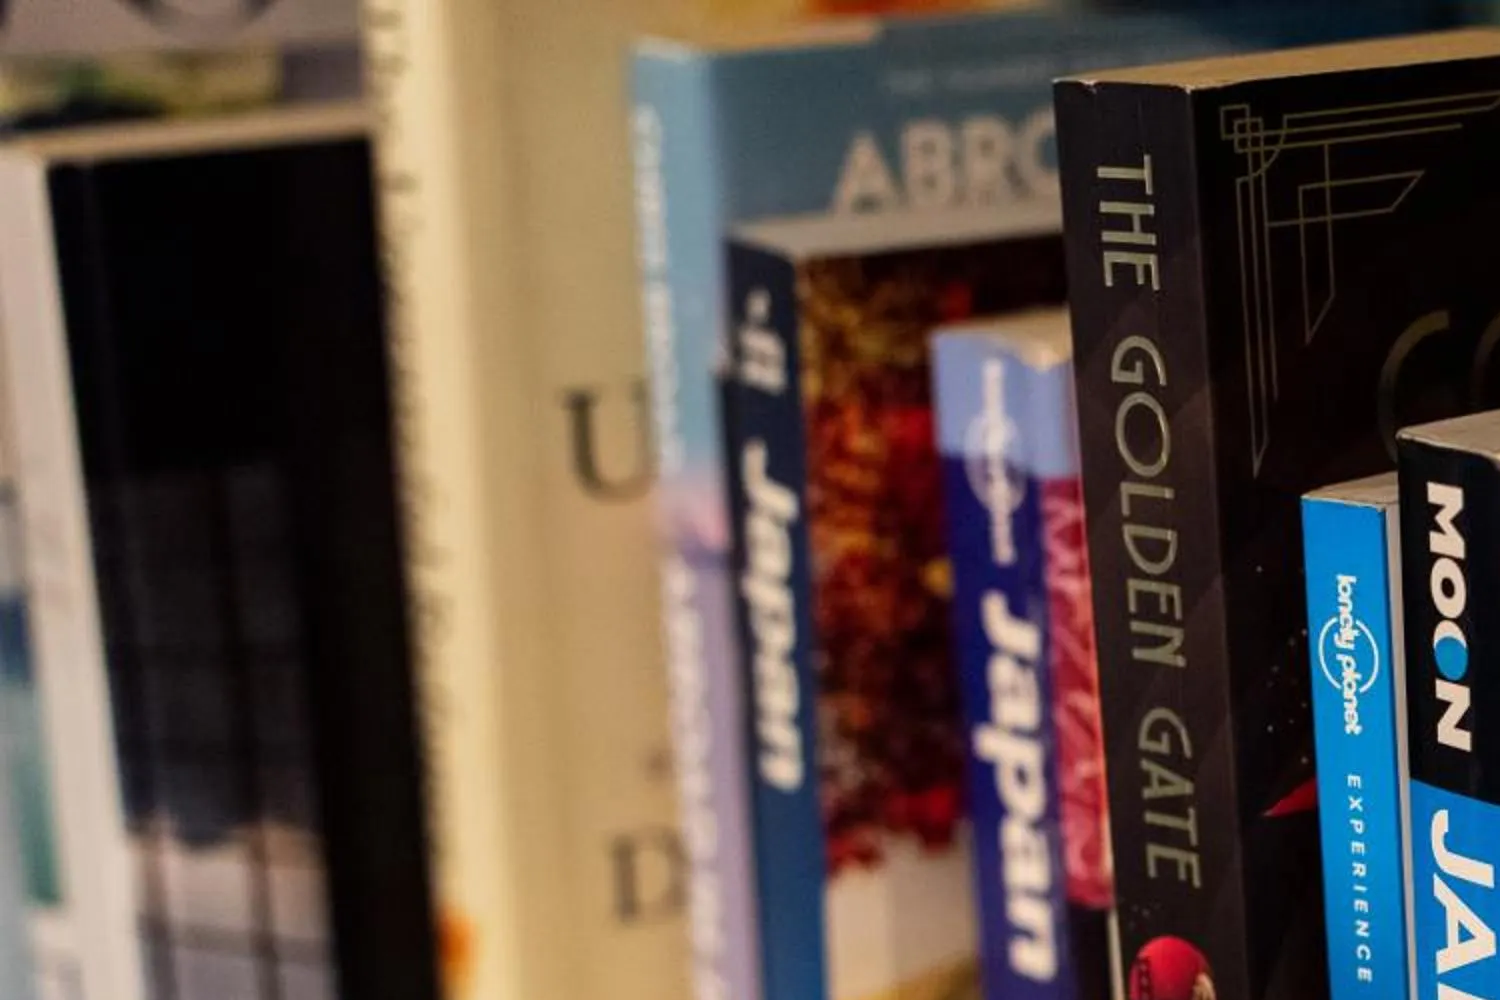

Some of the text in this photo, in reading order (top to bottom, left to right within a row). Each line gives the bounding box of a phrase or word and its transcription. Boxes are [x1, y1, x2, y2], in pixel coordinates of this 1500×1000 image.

[742, 437, 806, 790] Japan
[1097, 153, 1201, 888] THE GOLDEN GATE
[1334, 573, 1363, 736] lonely planet
[1427, 481, 1472, 753] MOON
[973, 588, 1058, 984] Japan
[1347, 773, 1373, 984] EXPERIENCE
